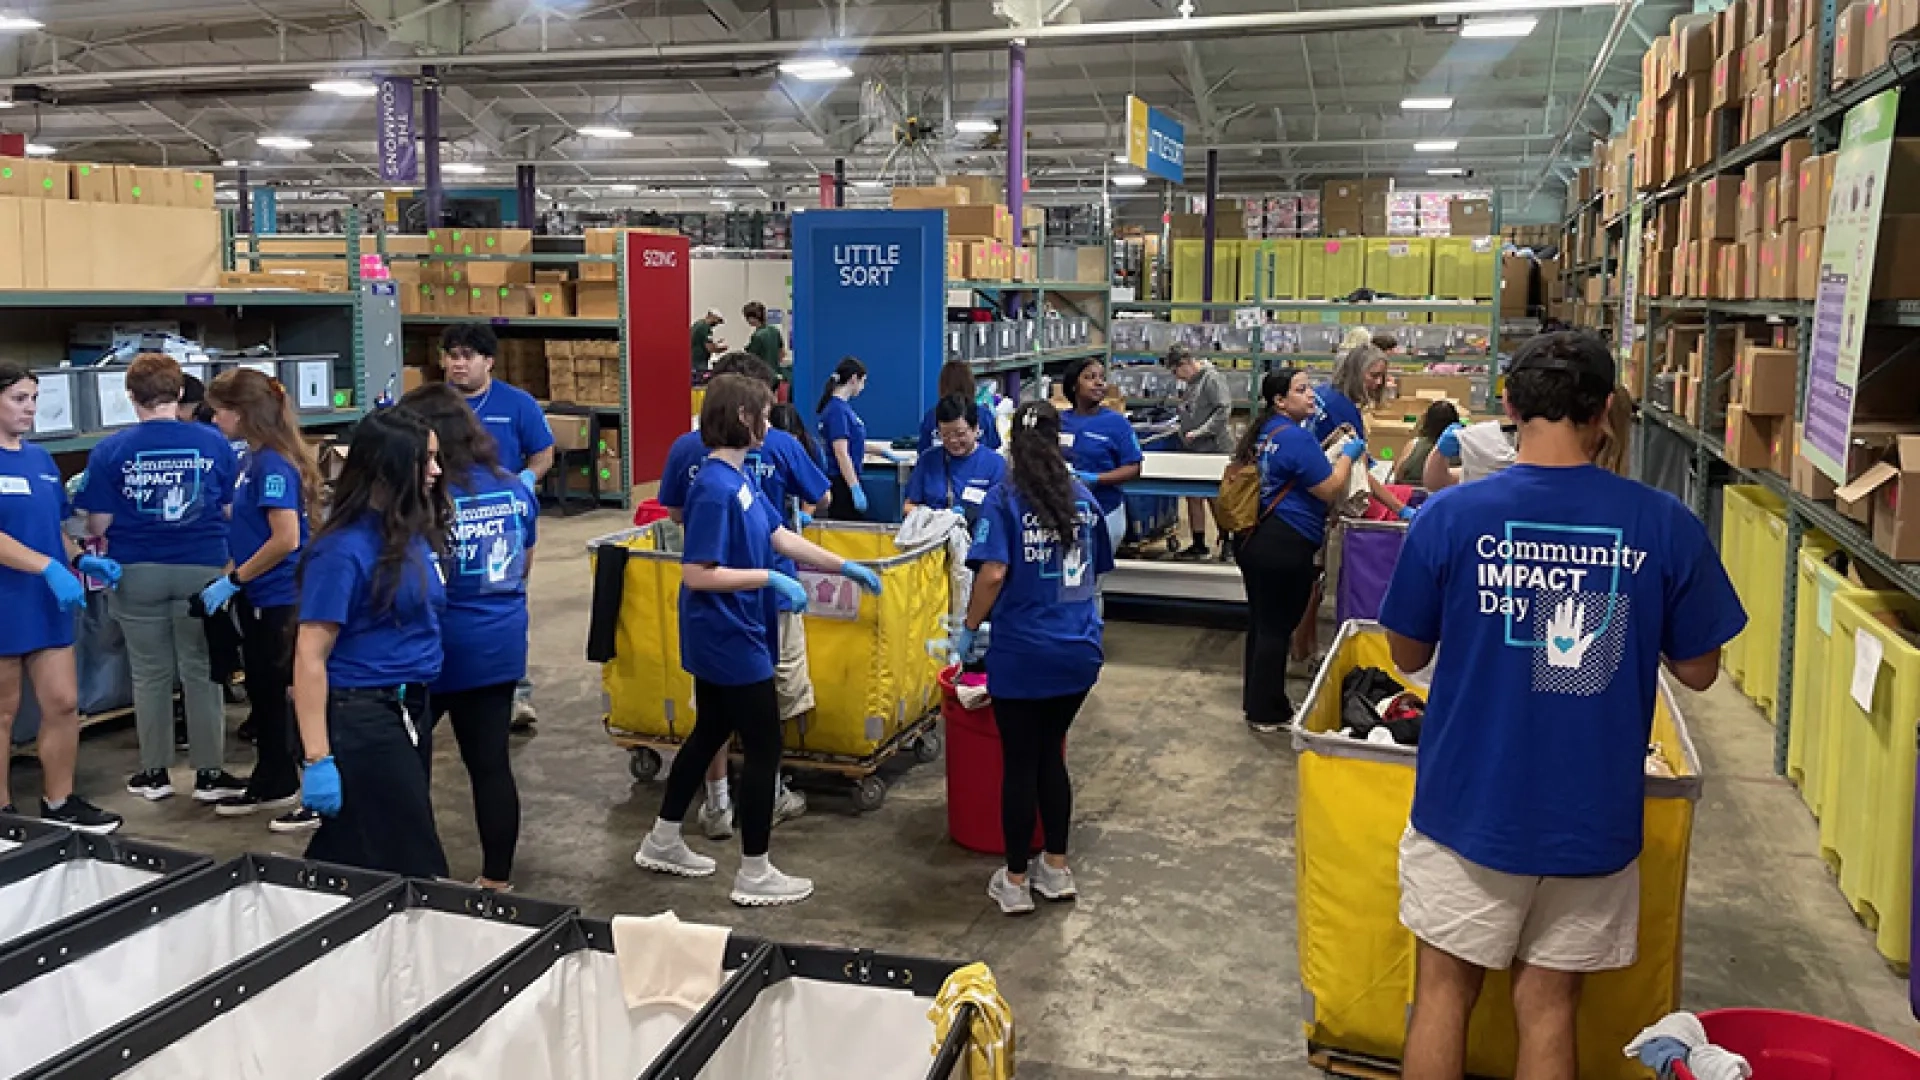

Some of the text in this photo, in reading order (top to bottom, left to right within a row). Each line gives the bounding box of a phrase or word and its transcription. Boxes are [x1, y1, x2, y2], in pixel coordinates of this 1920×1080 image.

[382, 81, 398, 176] COMMONS
[397, 112, 409, 145] THE
[642, 249, 678, 267] SIZING
[834, 244, 901, 265] LITTLE
[839, 265, 894, 287] SORT
[121, 458, 214, 474] Community
[124, 470, 185, 486] IMPACT
[122, 486, 154, 502] Day
[1024, 546, 1052, 563] Day
[1476, 534, 1648, 575] Community
[1477, 563, 1588, 593] IMPACT
[1477, 589, 1530, 623] Day
